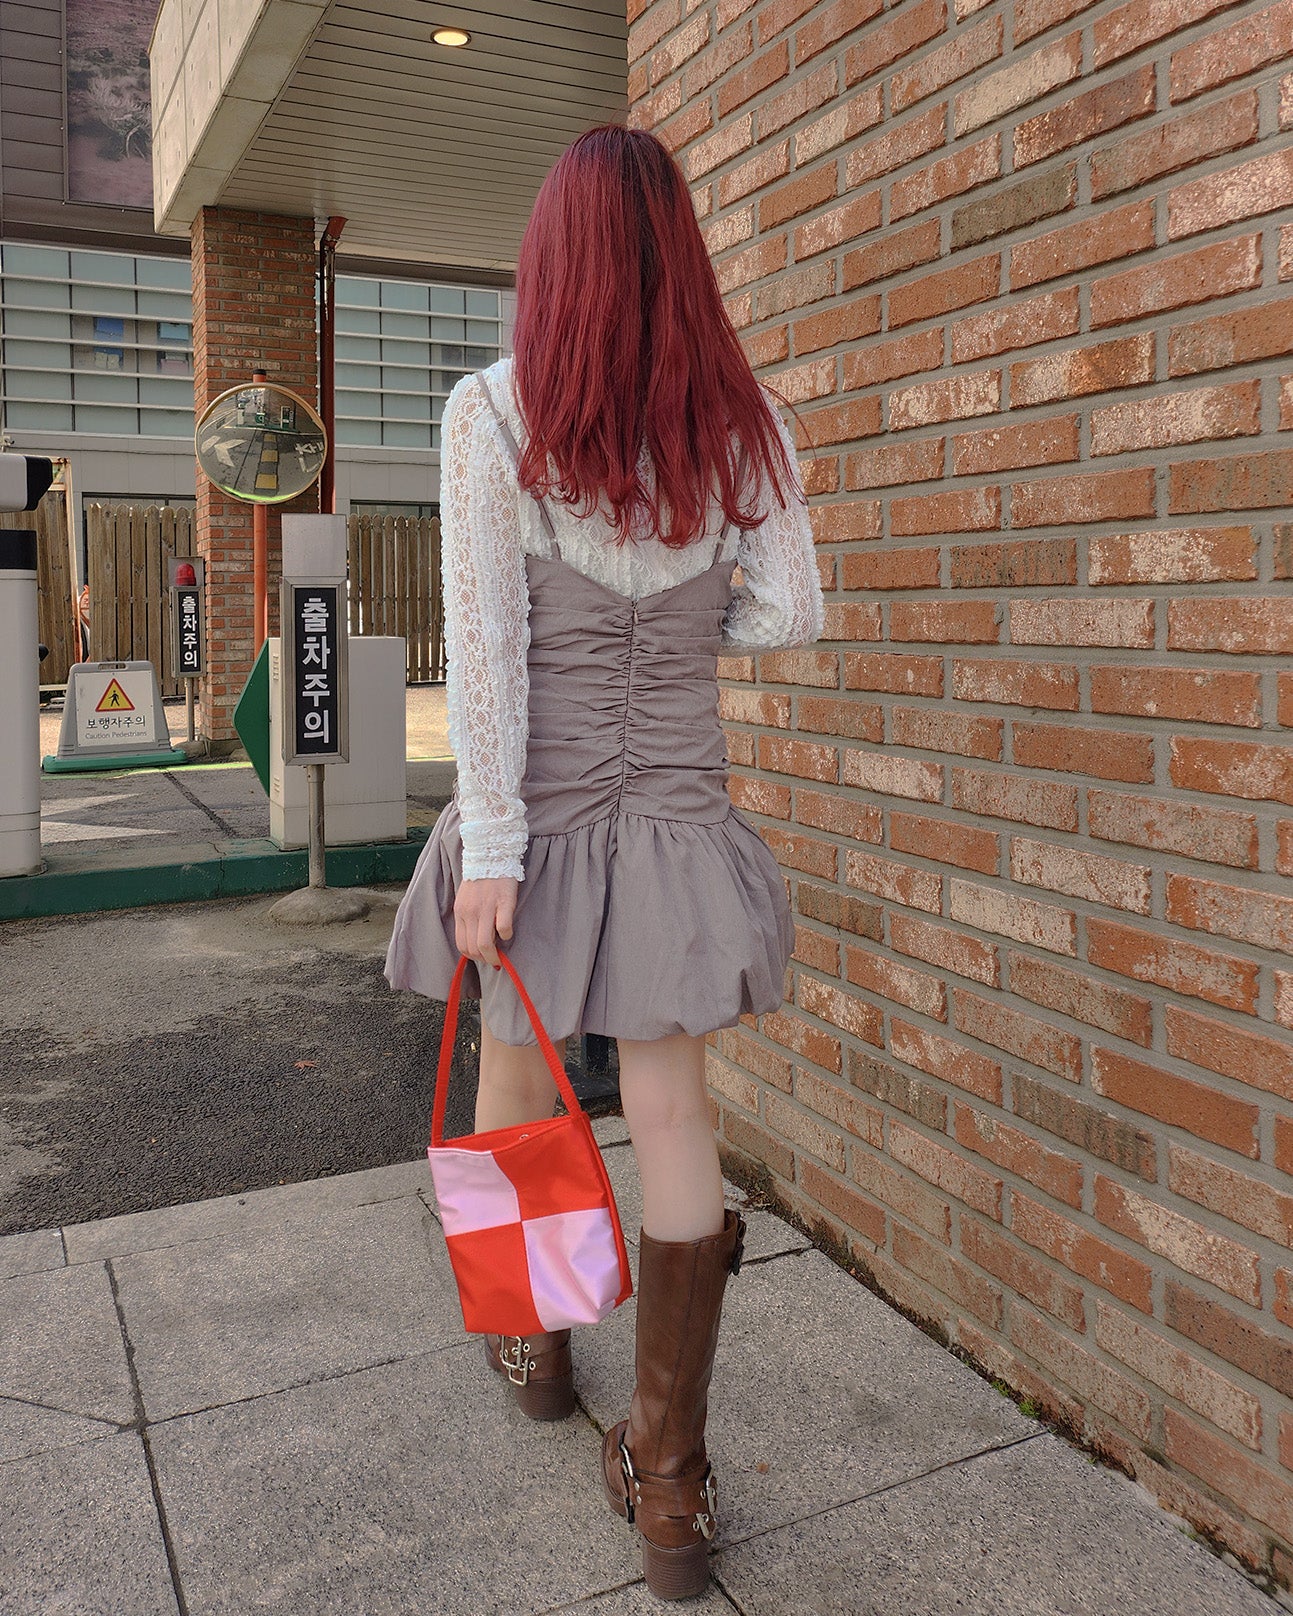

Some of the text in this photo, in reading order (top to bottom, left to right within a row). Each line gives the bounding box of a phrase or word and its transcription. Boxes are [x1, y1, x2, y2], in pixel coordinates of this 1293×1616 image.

[181, 595, 198, 668] 출차주의
[301, 597, 331, 744] 출차주의
[86, 715, 146, 729] 보행자주의
[112, 730, 147, 738] Pedestrians
